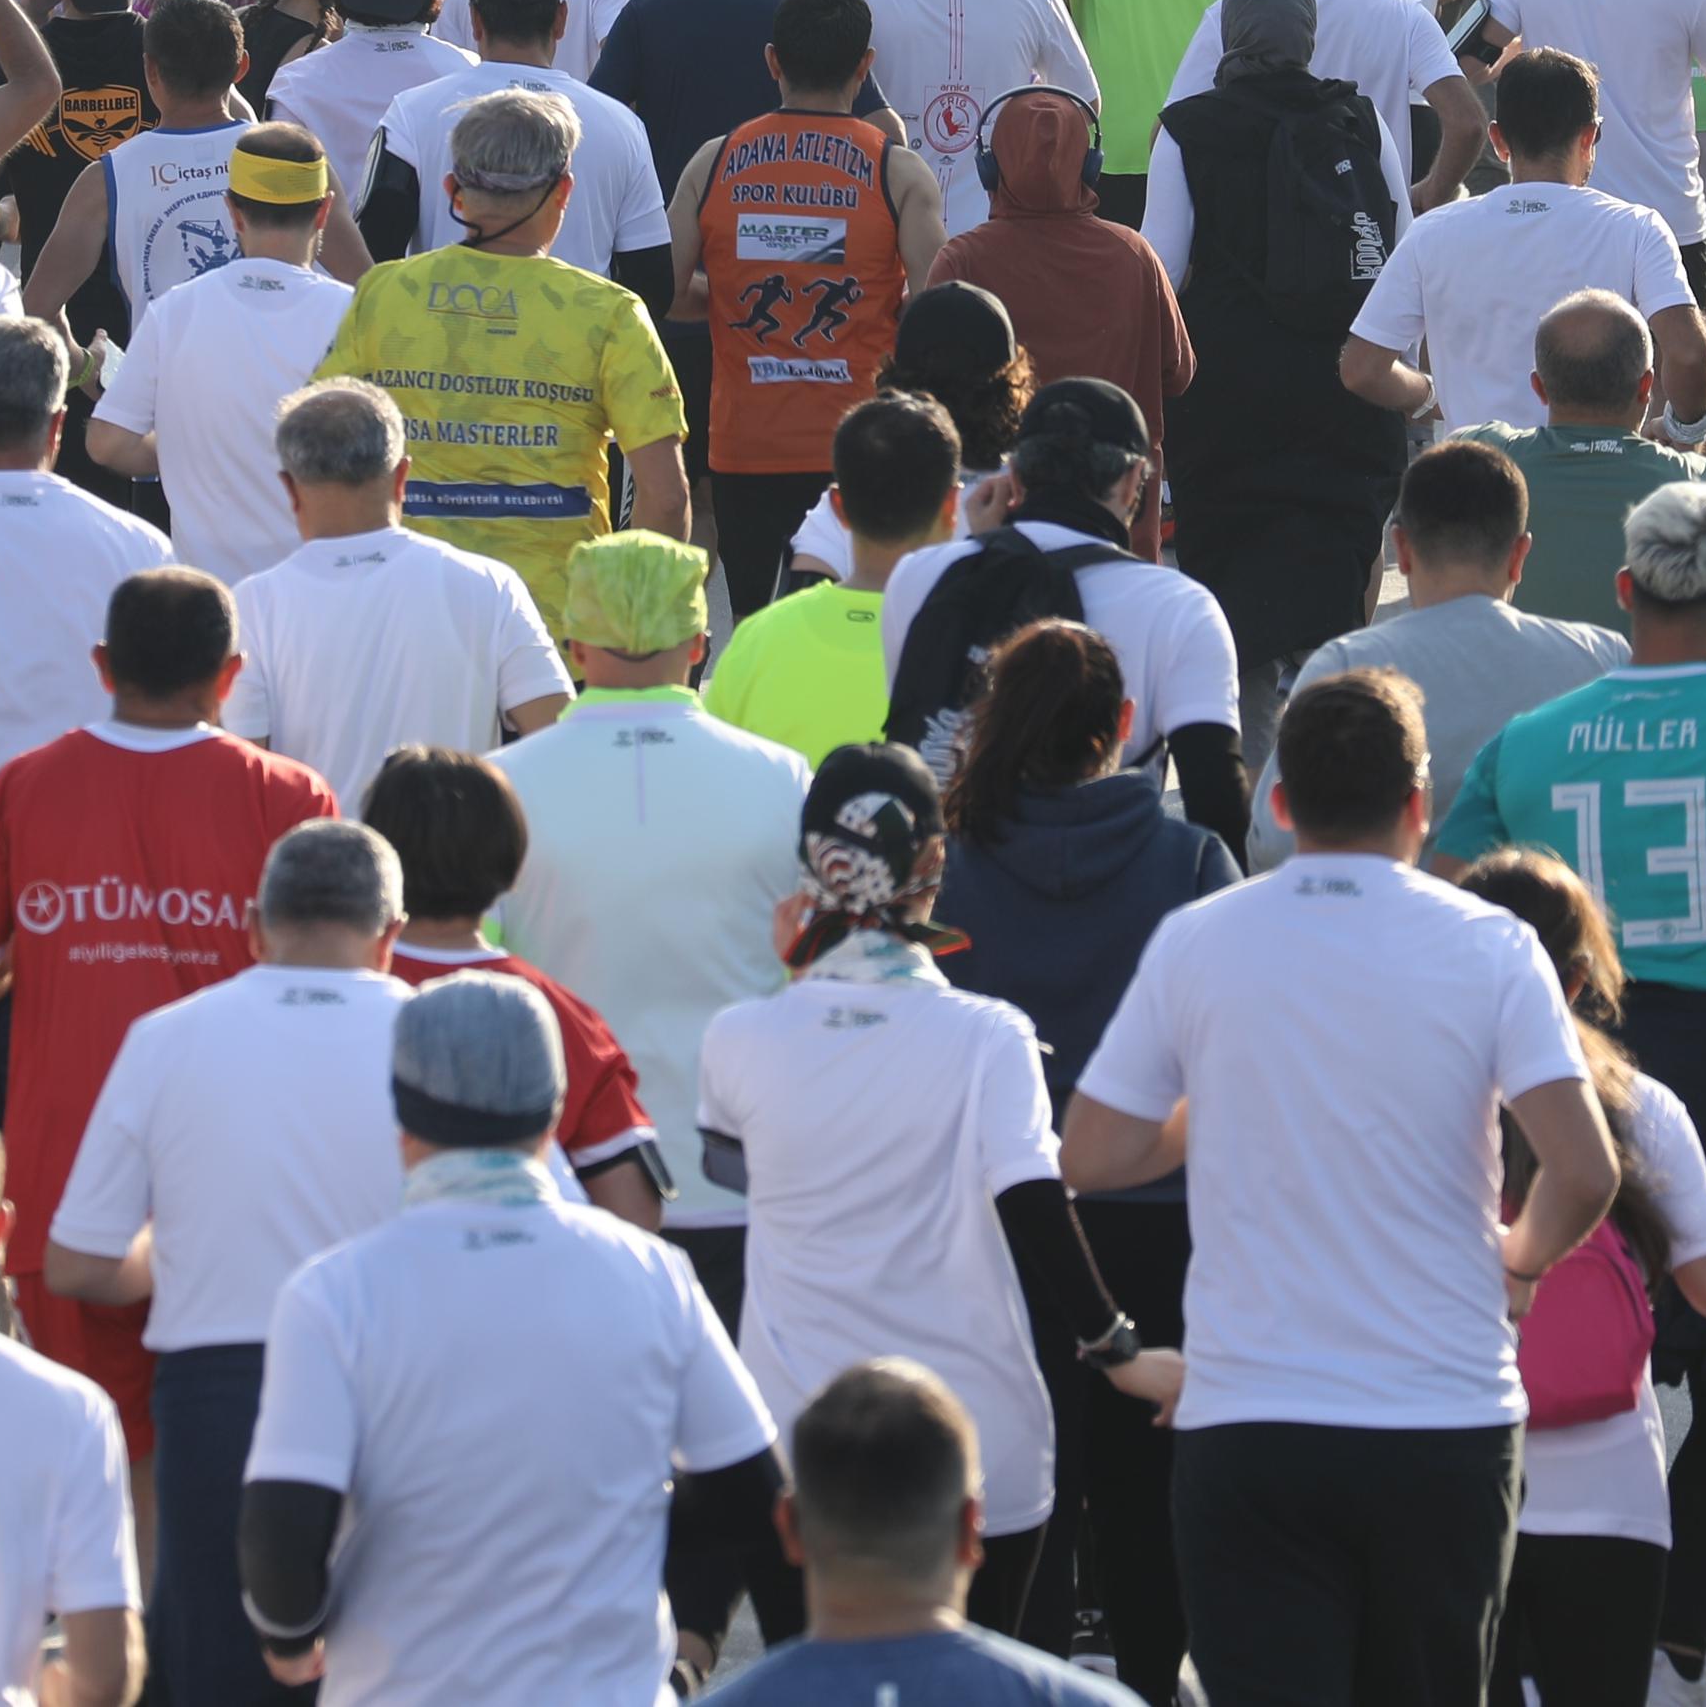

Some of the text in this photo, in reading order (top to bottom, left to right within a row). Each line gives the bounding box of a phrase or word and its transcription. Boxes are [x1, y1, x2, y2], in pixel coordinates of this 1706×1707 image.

[940, 83, 970, 93] arnica
[64, 95, 136, 113] BARBELLBEE
[721, 132, 875, 188] ADANA ATLETİZM
[731, 182, 859, 209] SPOR KULÜBÜ
[738, 223, 830, 238] MASTER
[439, 375, 518, 398] DOSTLUK
[524, 381, 594, 404] KOŞUSU
[437, 420, 558, 447] MASTERLER
[1567, 713, 1698, 754] MÜLLER
